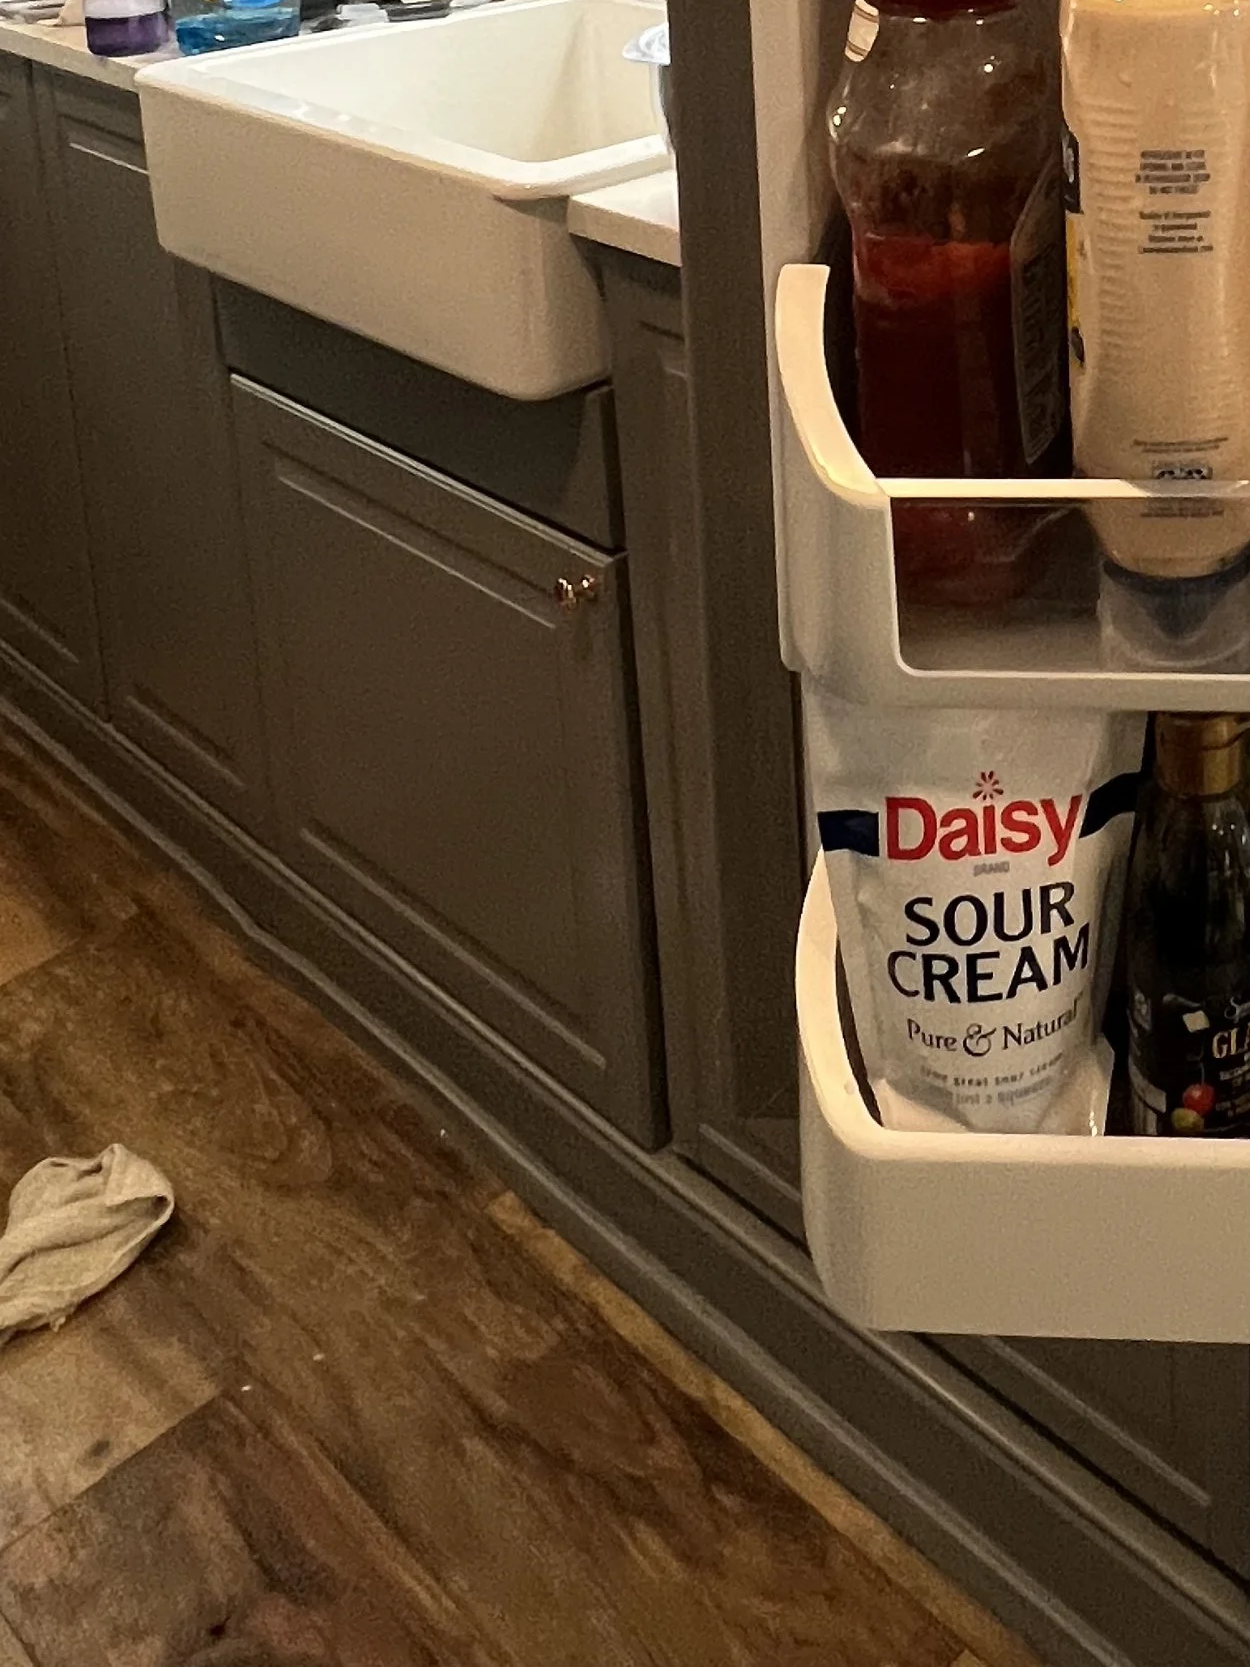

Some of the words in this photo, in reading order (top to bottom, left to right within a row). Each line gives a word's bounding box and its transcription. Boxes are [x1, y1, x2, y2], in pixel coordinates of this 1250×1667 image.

[884, 795, 1083, 867] Daisy
[973, 860, 1010, 877] BRAND
[903, 881, 1075, 946] SOUR
[886, 922, 1090, 1003] CREAM
[907, 1018, 958, 1052] Pure
[962, 1022, 1007, 1057] &
[1002, 996, 1080, 1051] Natural
